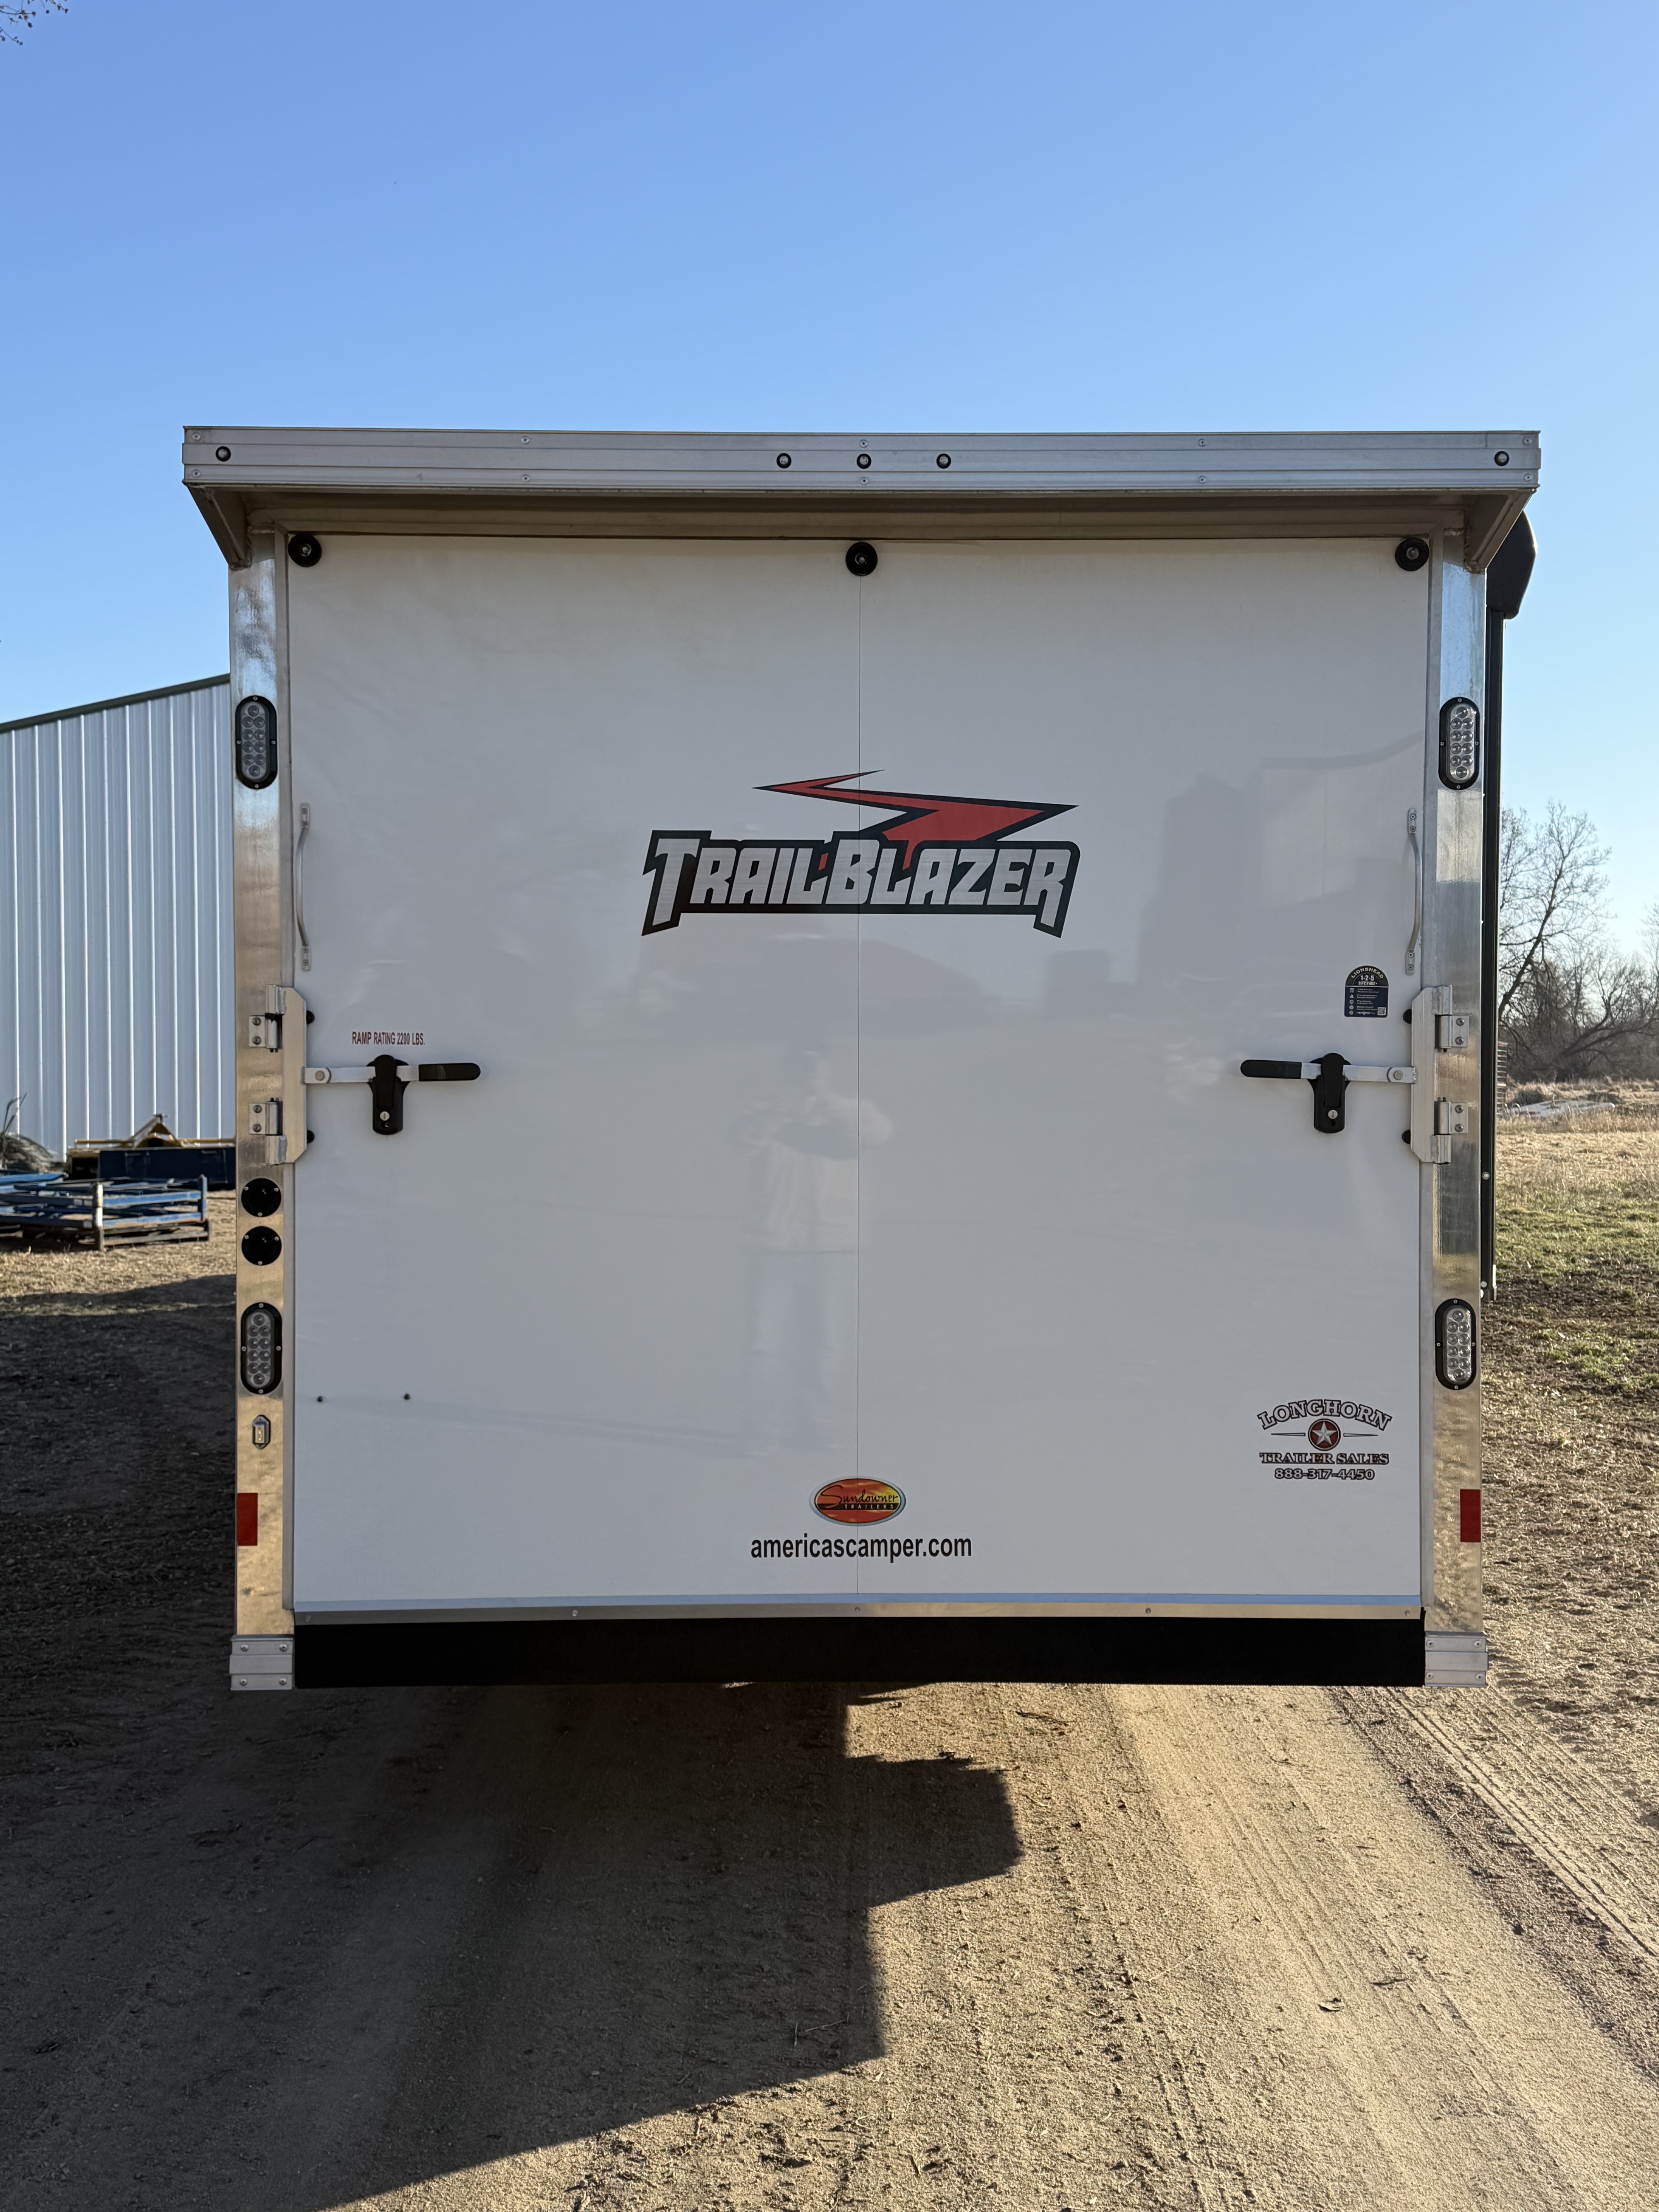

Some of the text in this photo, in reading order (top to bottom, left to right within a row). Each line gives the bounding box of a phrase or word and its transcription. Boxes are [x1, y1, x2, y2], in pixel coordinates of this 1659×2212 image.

[1351, 967, 1384, 979] LIONSHEAD
[352, 1032, 425, 1045] RAMP RATING 2200 LBS.
[1257, 1399, 1393, 1431] LONGHORN
[1259, 1453, 1389, 1465] TRAILER SALES
[1274, 1468, 1375, 1480] 888-317-4450
[820, 1485, 898, 1508] Sundowner
[751, 1533, 972, 1563] americascamper.com
